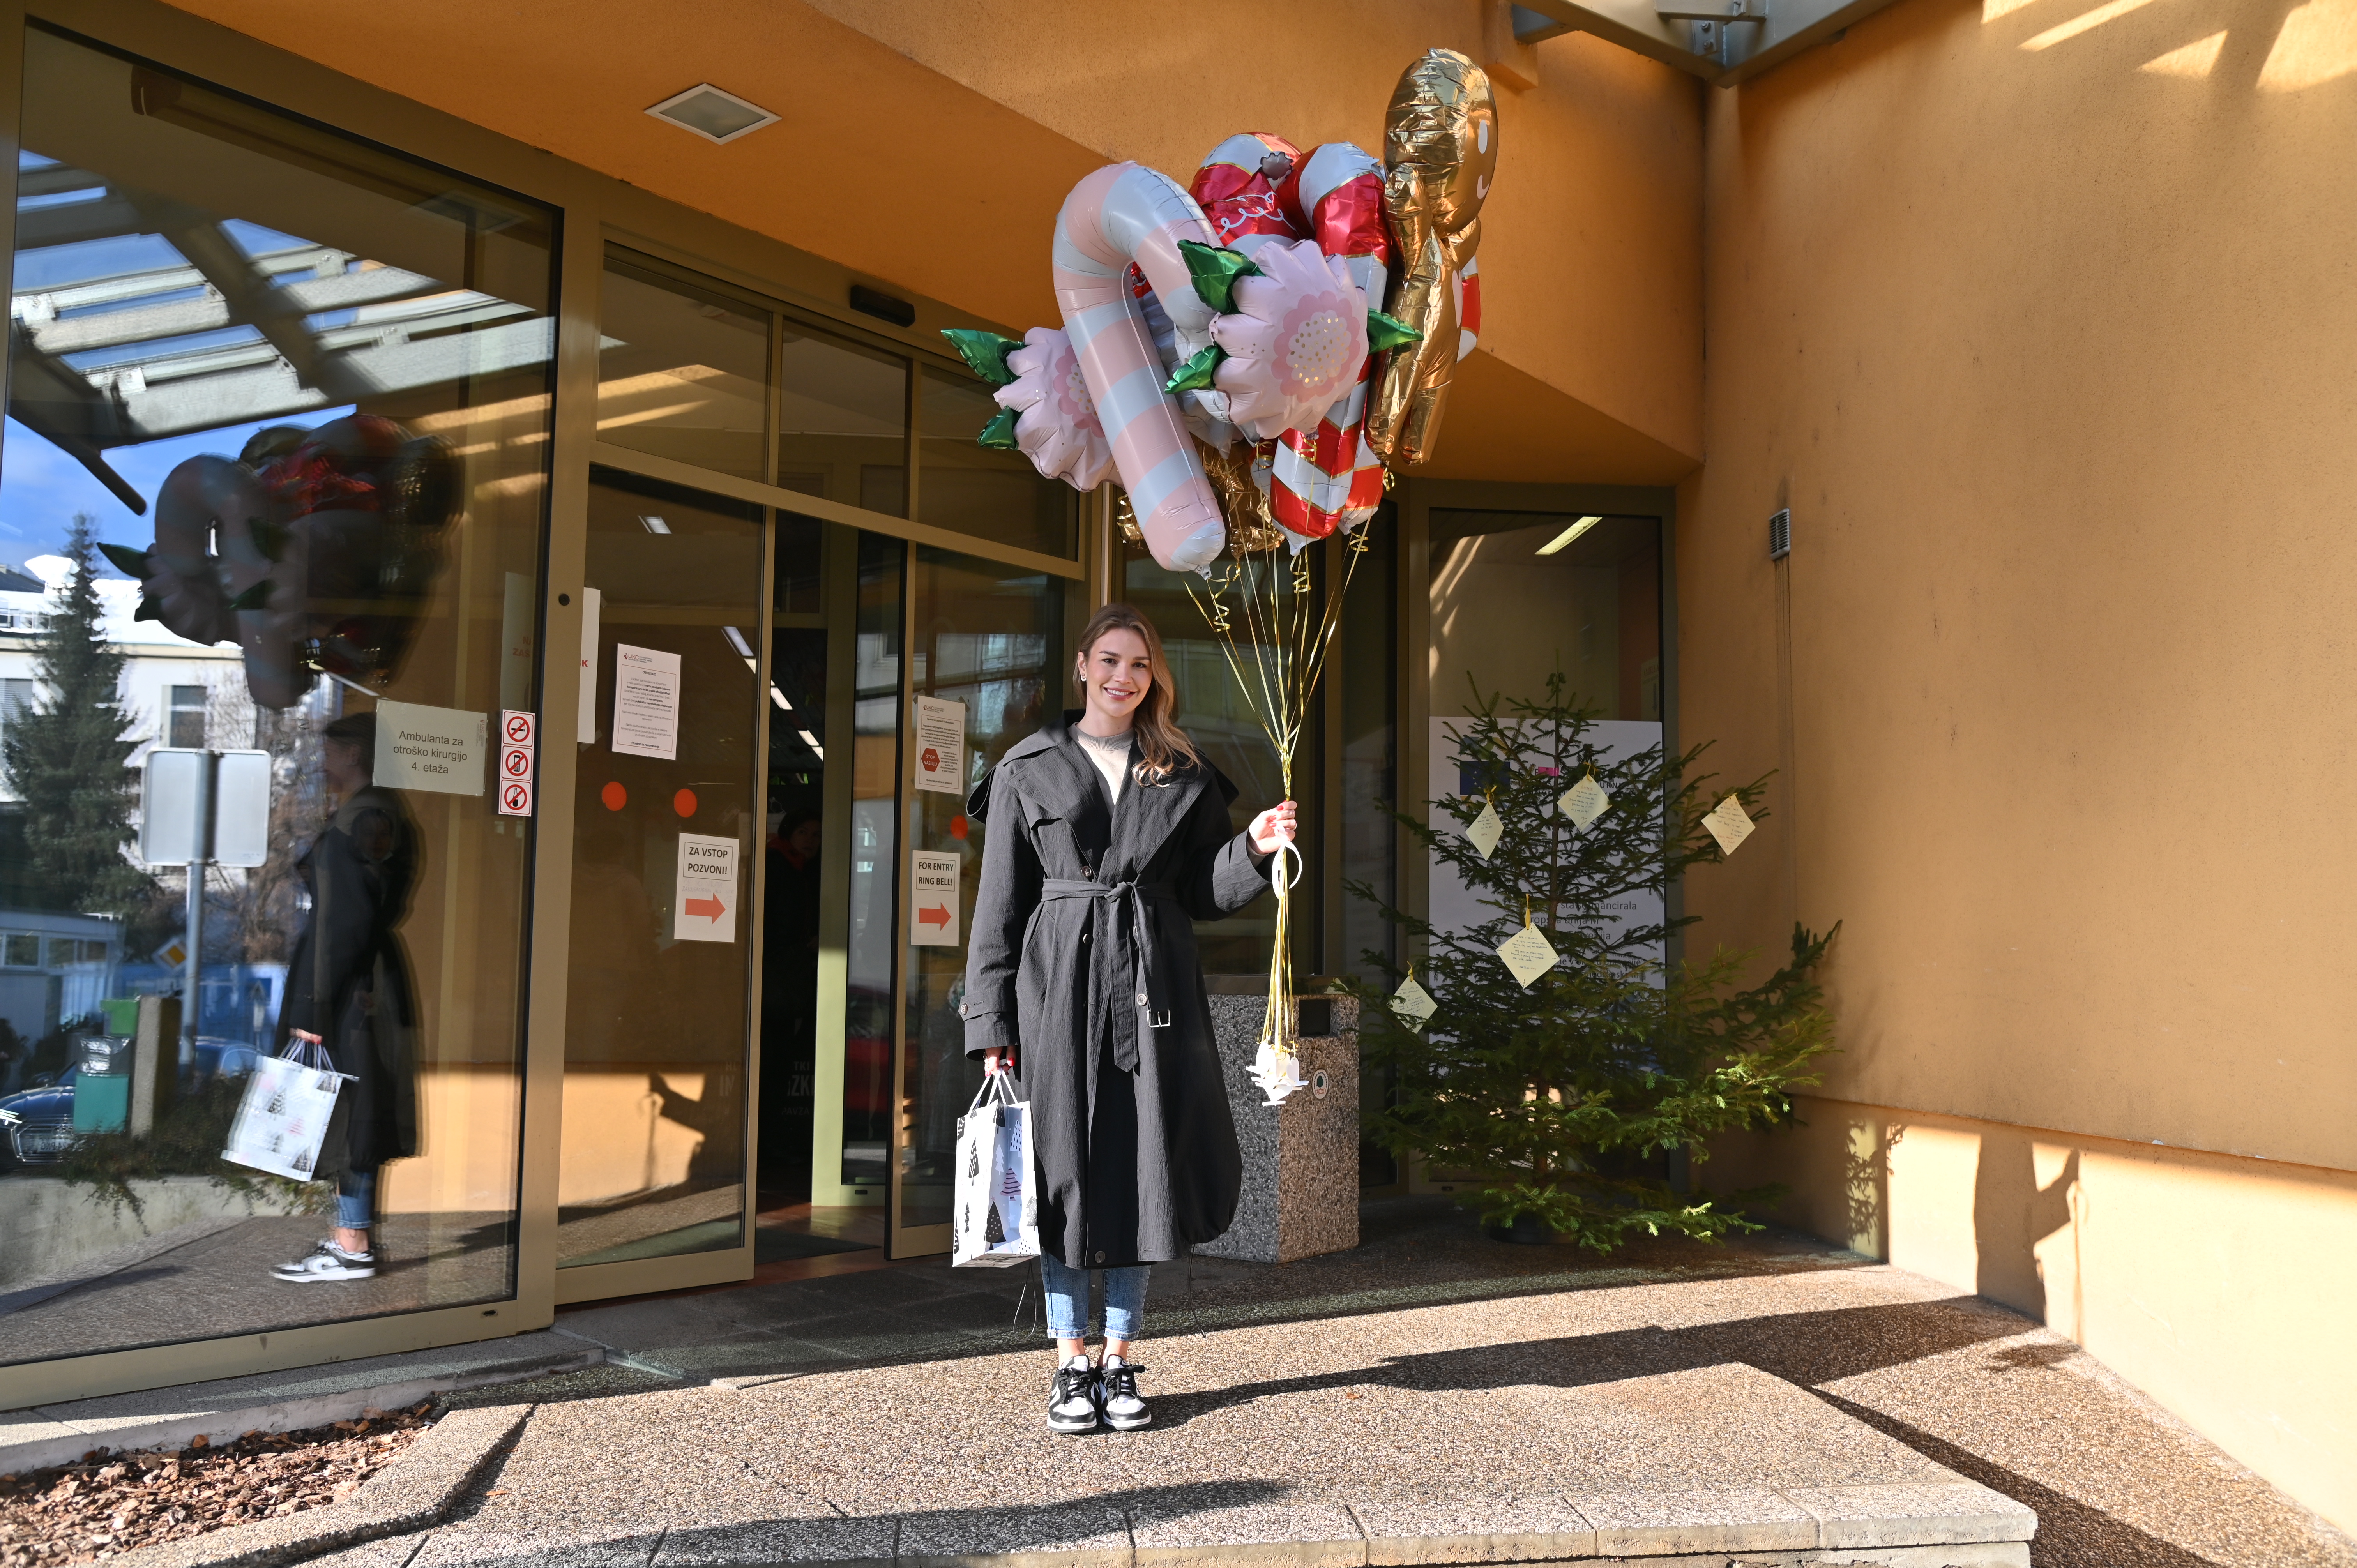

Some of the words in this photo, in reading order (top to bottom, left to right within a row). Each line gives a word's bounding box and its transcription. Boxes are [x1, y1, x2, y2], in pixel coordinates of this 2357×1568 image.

[399, 730, 449, 745] Ambulanta
[452, 738, 463, 746] za
[393, 745, 428, 757] otroško
[431, 748, 467, 763] kirurgijo
[411, 762, 420, 771] 4.
[423, 764, 449, 774] etaža
[689, 847, 700, 856] ZA
[701, 848, 728, 858] VSTOP
[688, 863, 728, 875] POZVONI!
[919, 862, 931, 870] FOR
[933, 863, 954, 871] ENTRY
[936, 878, 953, 886] BELL!
